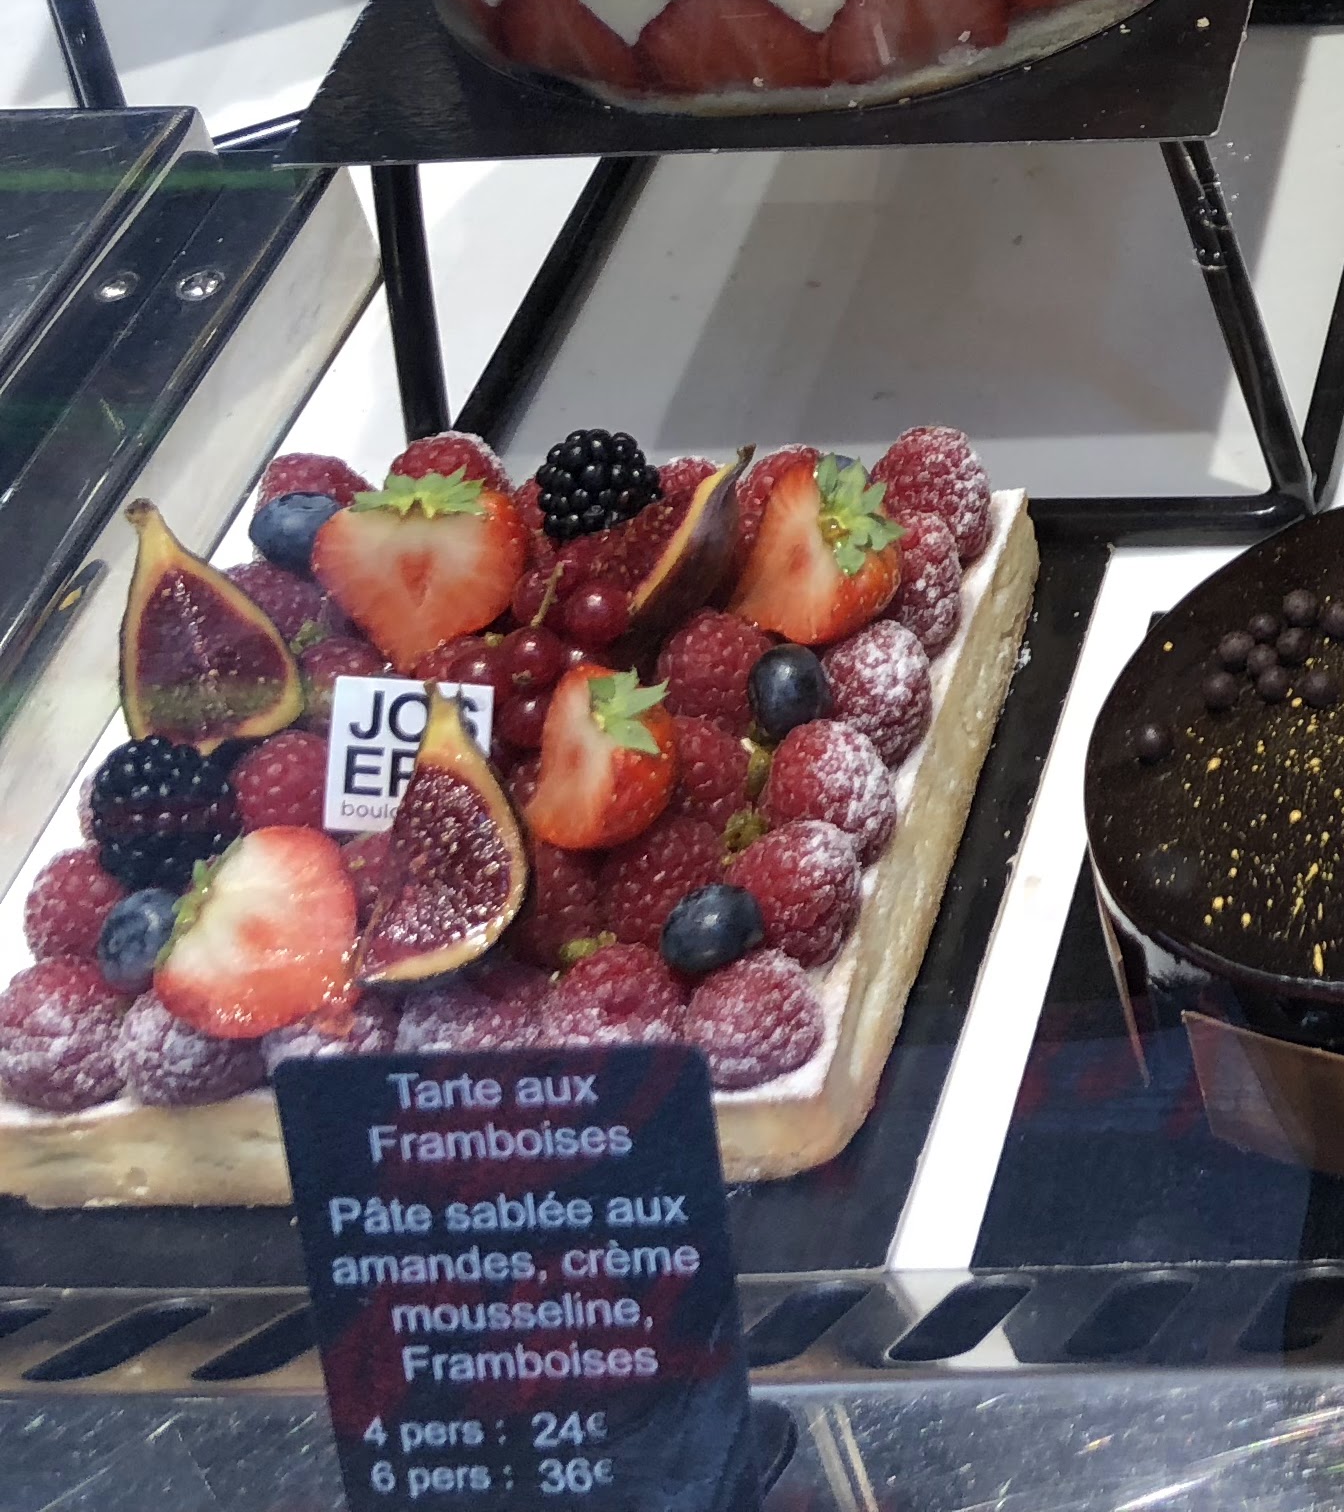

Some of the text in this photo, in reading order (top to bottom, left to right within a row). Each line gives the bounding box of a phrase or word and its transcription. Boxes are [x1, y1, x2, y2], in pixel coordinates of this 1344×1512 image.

[387, 1073, 598, 1109] Tarte aux
[368, 1120, 632, 1162] Framboises
[329, 1191, 688, 1234] Pâte sablée aux
[333, 1240, 700, 1285] amandes, crème
[392, 1292, 653, 1333] mousseline,
[402, 1341, 658, 1381] Framboises
[363, 1412, 606, 1453] 4 pers 24€
[371, 1458, 613, 1499] 6 pers 36€
